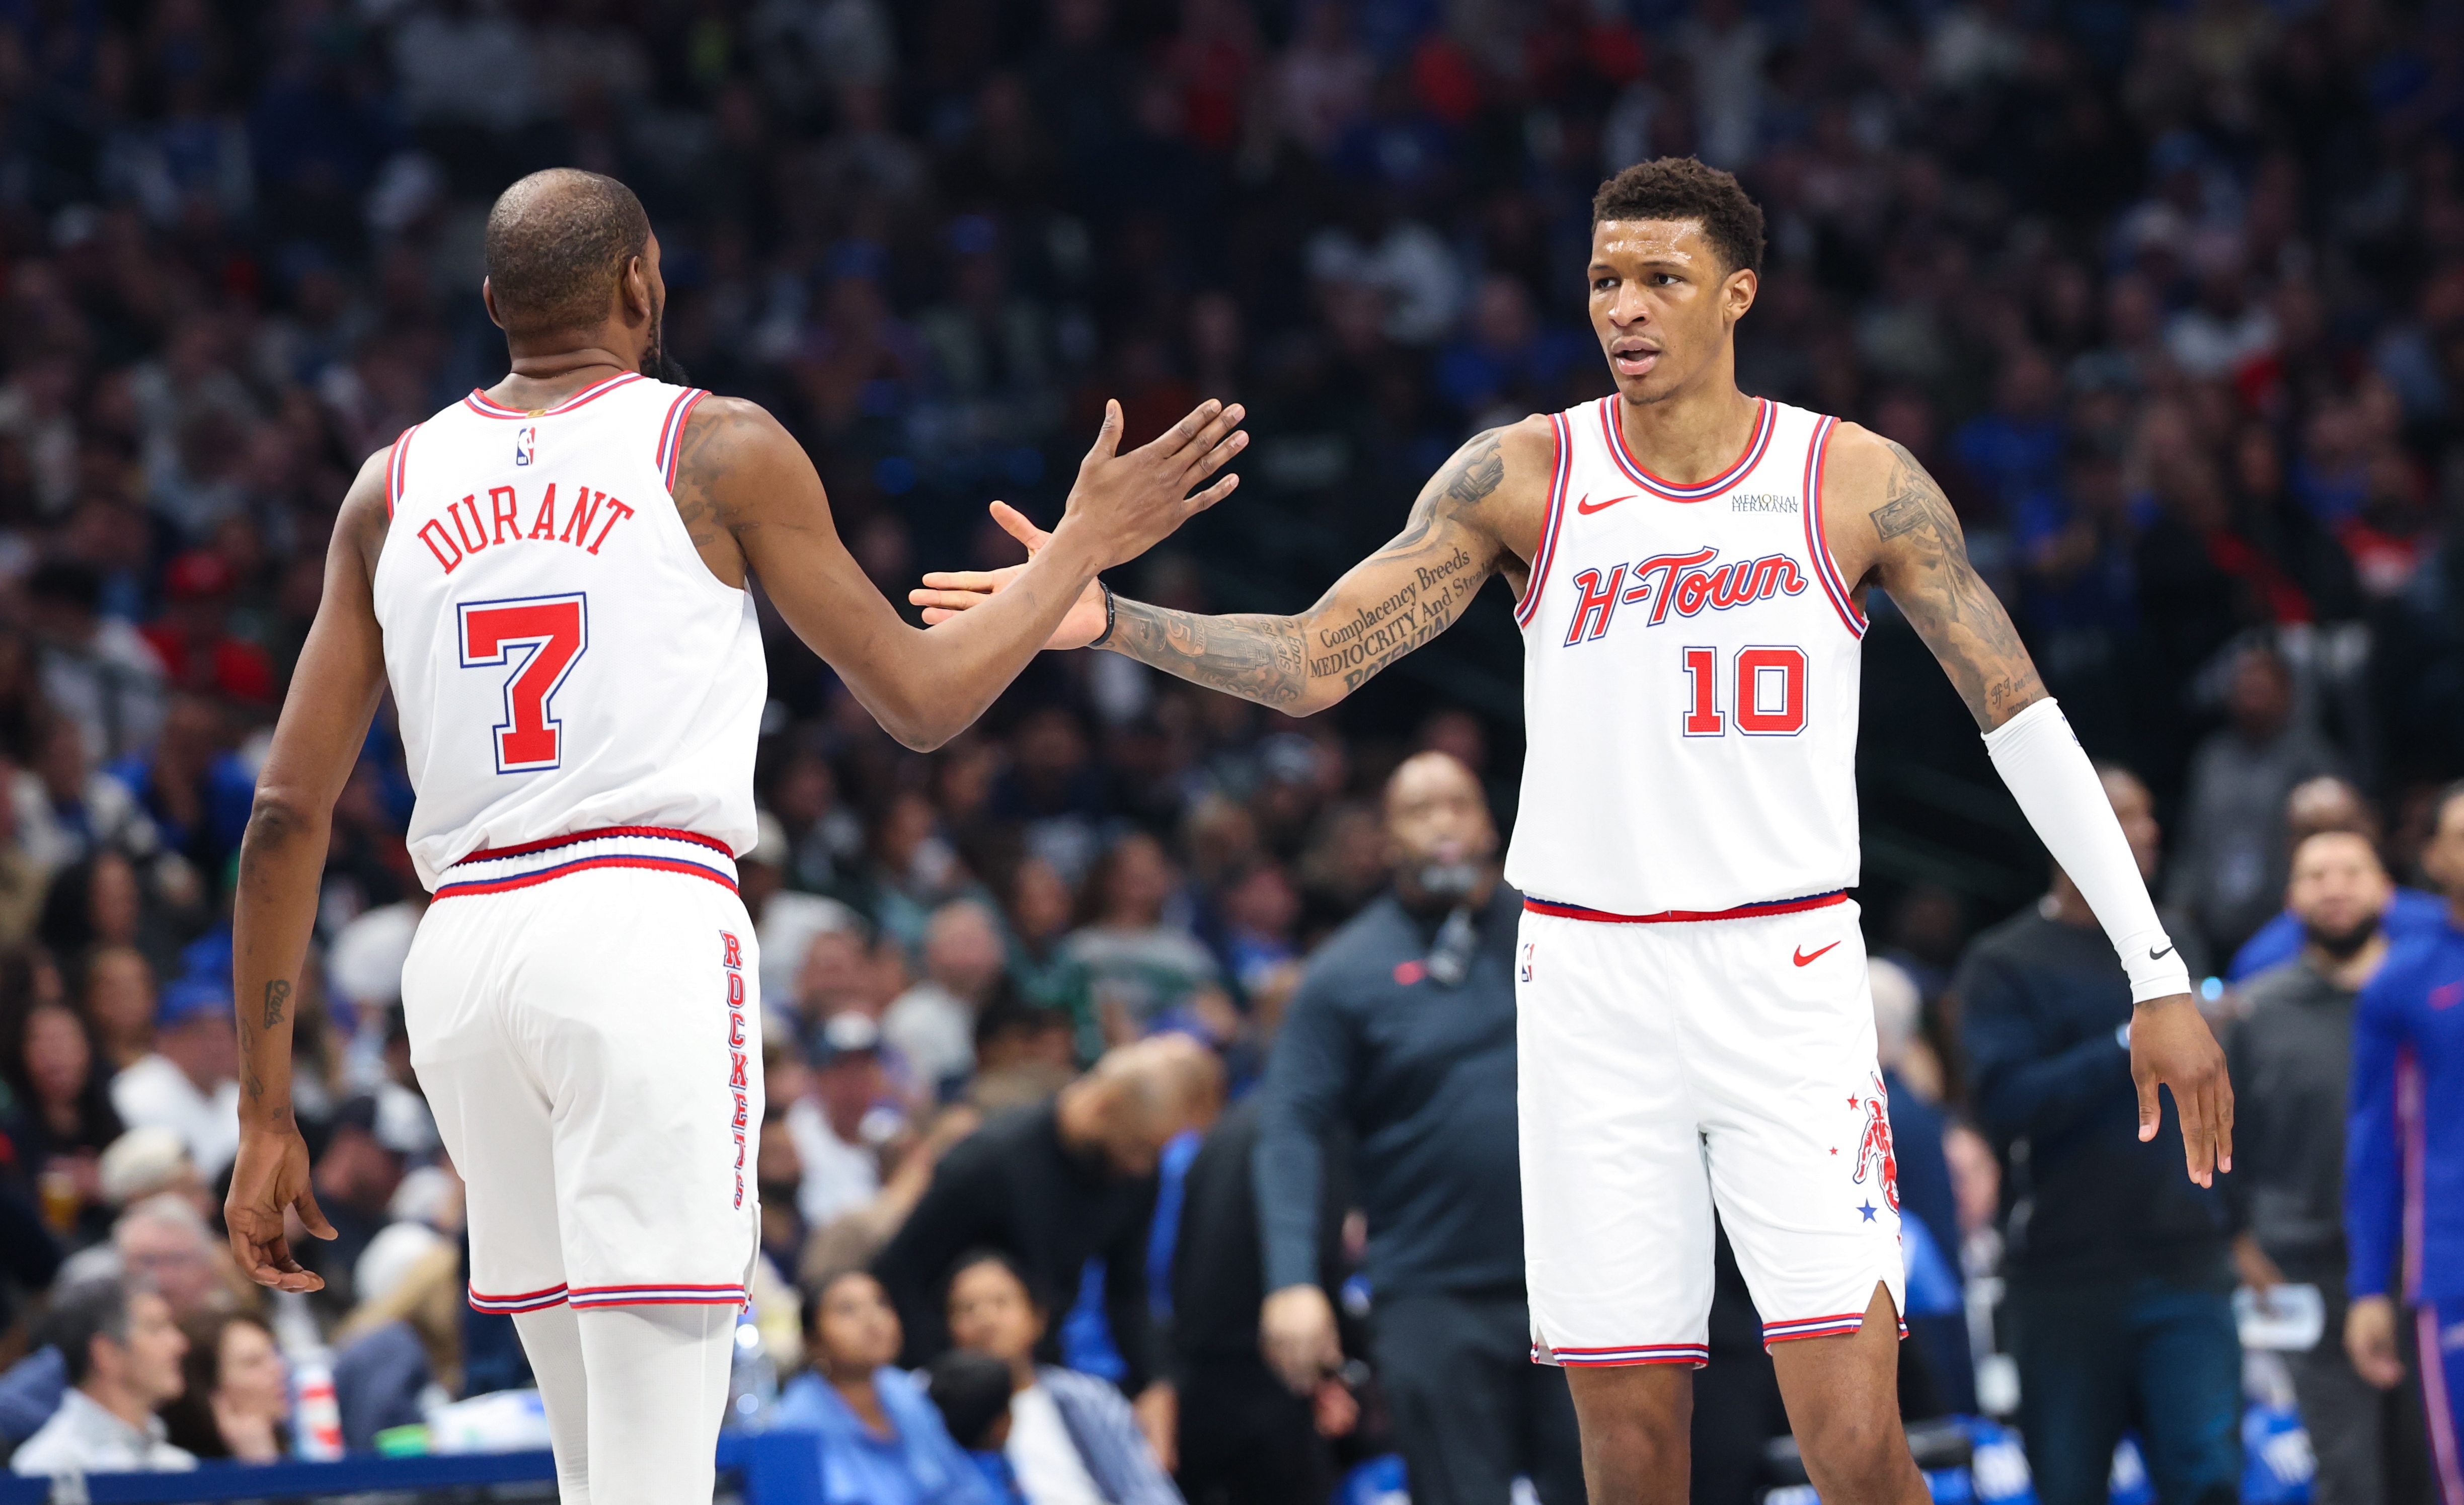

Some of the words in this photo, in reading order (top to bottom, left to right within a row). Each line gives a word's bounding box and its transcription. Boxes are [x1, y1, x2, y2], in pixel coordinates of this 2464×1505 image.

[517, 456, 527, 464] NBA
[1732, 494, 1798, 505] MEMORIAL
[417, 483, 635, 575] DURANT
[1732, 503, 1798, 513] HERMANN
[1310, 607, 1420, 678] MEDIOCRITY
[1422, 587, 1453, 623] And
[1320, 582, 1417, 648] Complacency
[1415, 547, 1470, 592] Breeds
[1563, 546, 1808, 647] H-Town
[456, 591, 588, 775] 7
[1682, 645, 1808, 737] 10
[719, 929, 748, 1210] ROCKETS
